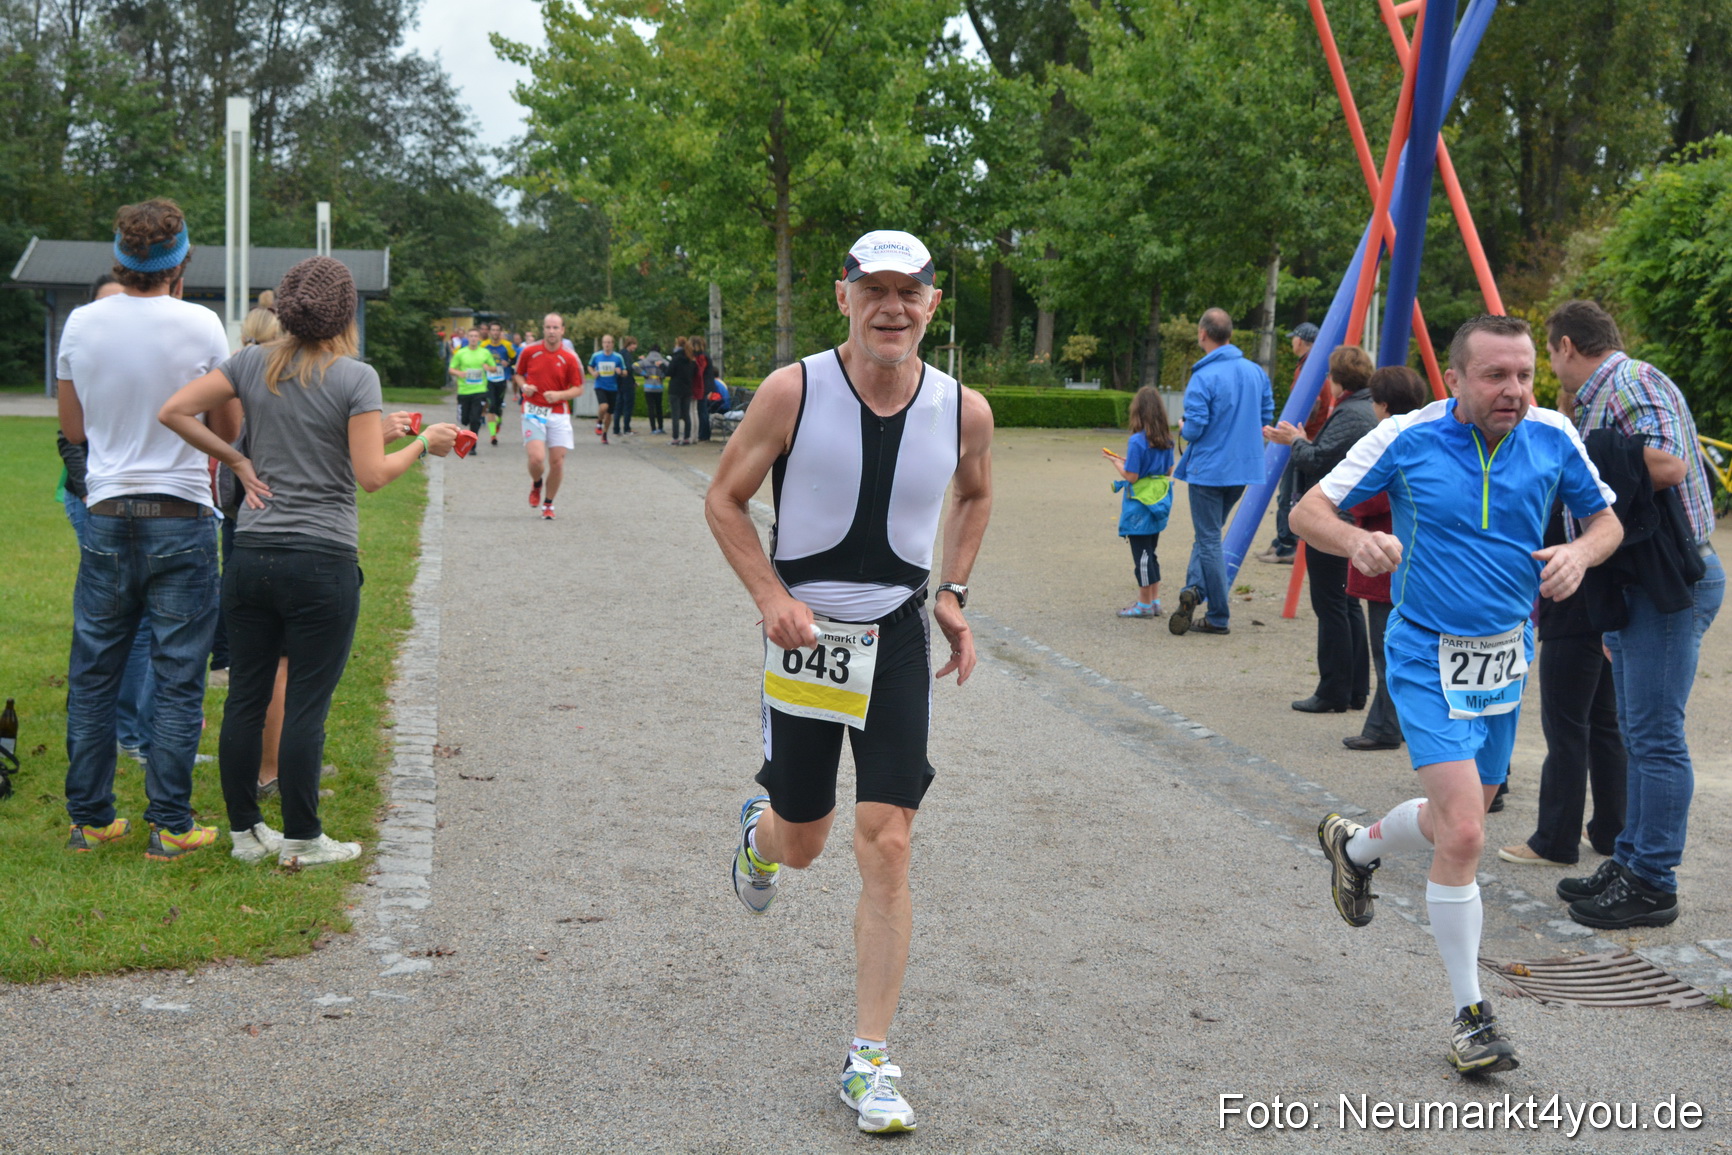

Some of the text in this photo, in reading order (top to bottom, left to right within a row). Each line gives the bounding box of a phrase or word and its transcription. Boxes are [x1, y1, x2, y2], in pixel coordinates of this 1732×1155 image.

[873, 244, 910, 252] ERDINGER
[823, 632, 857, 644] markt
[1441, 637, 1478, 650] PARTL
[782, 643, 851, 684] 643
[1450, 648, 1521, 685] 2732
